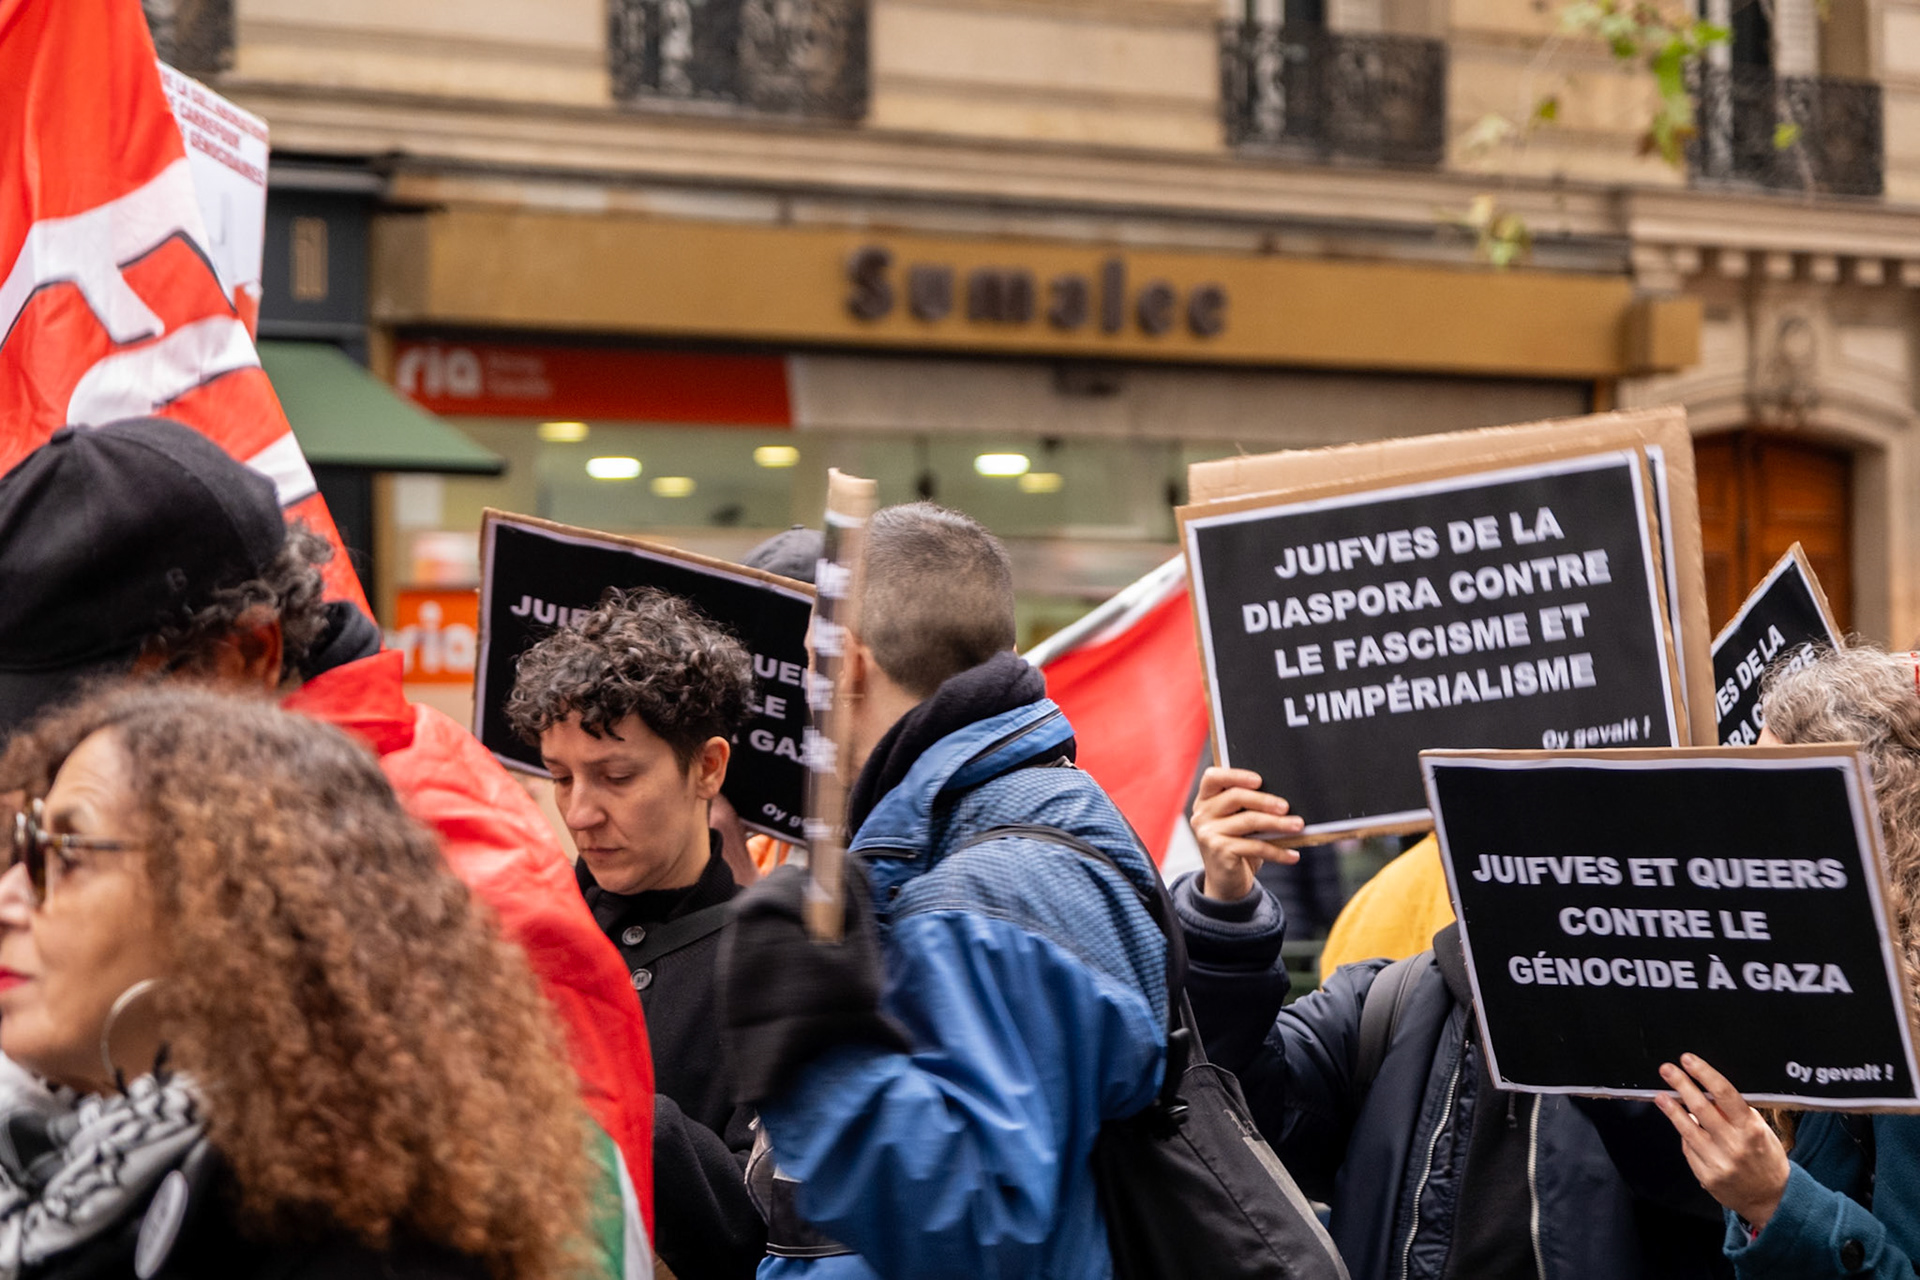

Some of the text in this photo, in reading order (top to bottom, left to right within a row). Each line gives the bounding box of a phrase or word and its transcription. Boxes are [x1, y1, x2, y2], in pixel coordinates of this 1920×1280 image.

[846, 244, 1227, 340] Sumalee
[397, 344, 481, 399] ria
[1275, 507, 1564, 578] JUIFVES DE LA
[1242, 549, 1611, 633] DIASPORA CONTRE
[400, 600, 475, 675] ria
[1275, 603, 1589, 678] LE FASCISME ET
[1735, 648, 1765, 690] DE
[1759, 624, 1786, 661] LA
[1574, 718, 1638, 748] gevalt
[762, 803, 787, 822] Oy
[1473, 854, 1846, 888] JUIFVES ET QUEERS
[1560, 907, 1770, 939] CONTRE LE
[1509, 951, 1852, 992] GÉNOCIDE À GAZA
[1786, 1061, 1813, 1083] Oy
[1815, 1063, 1882, 1084] gevalt
